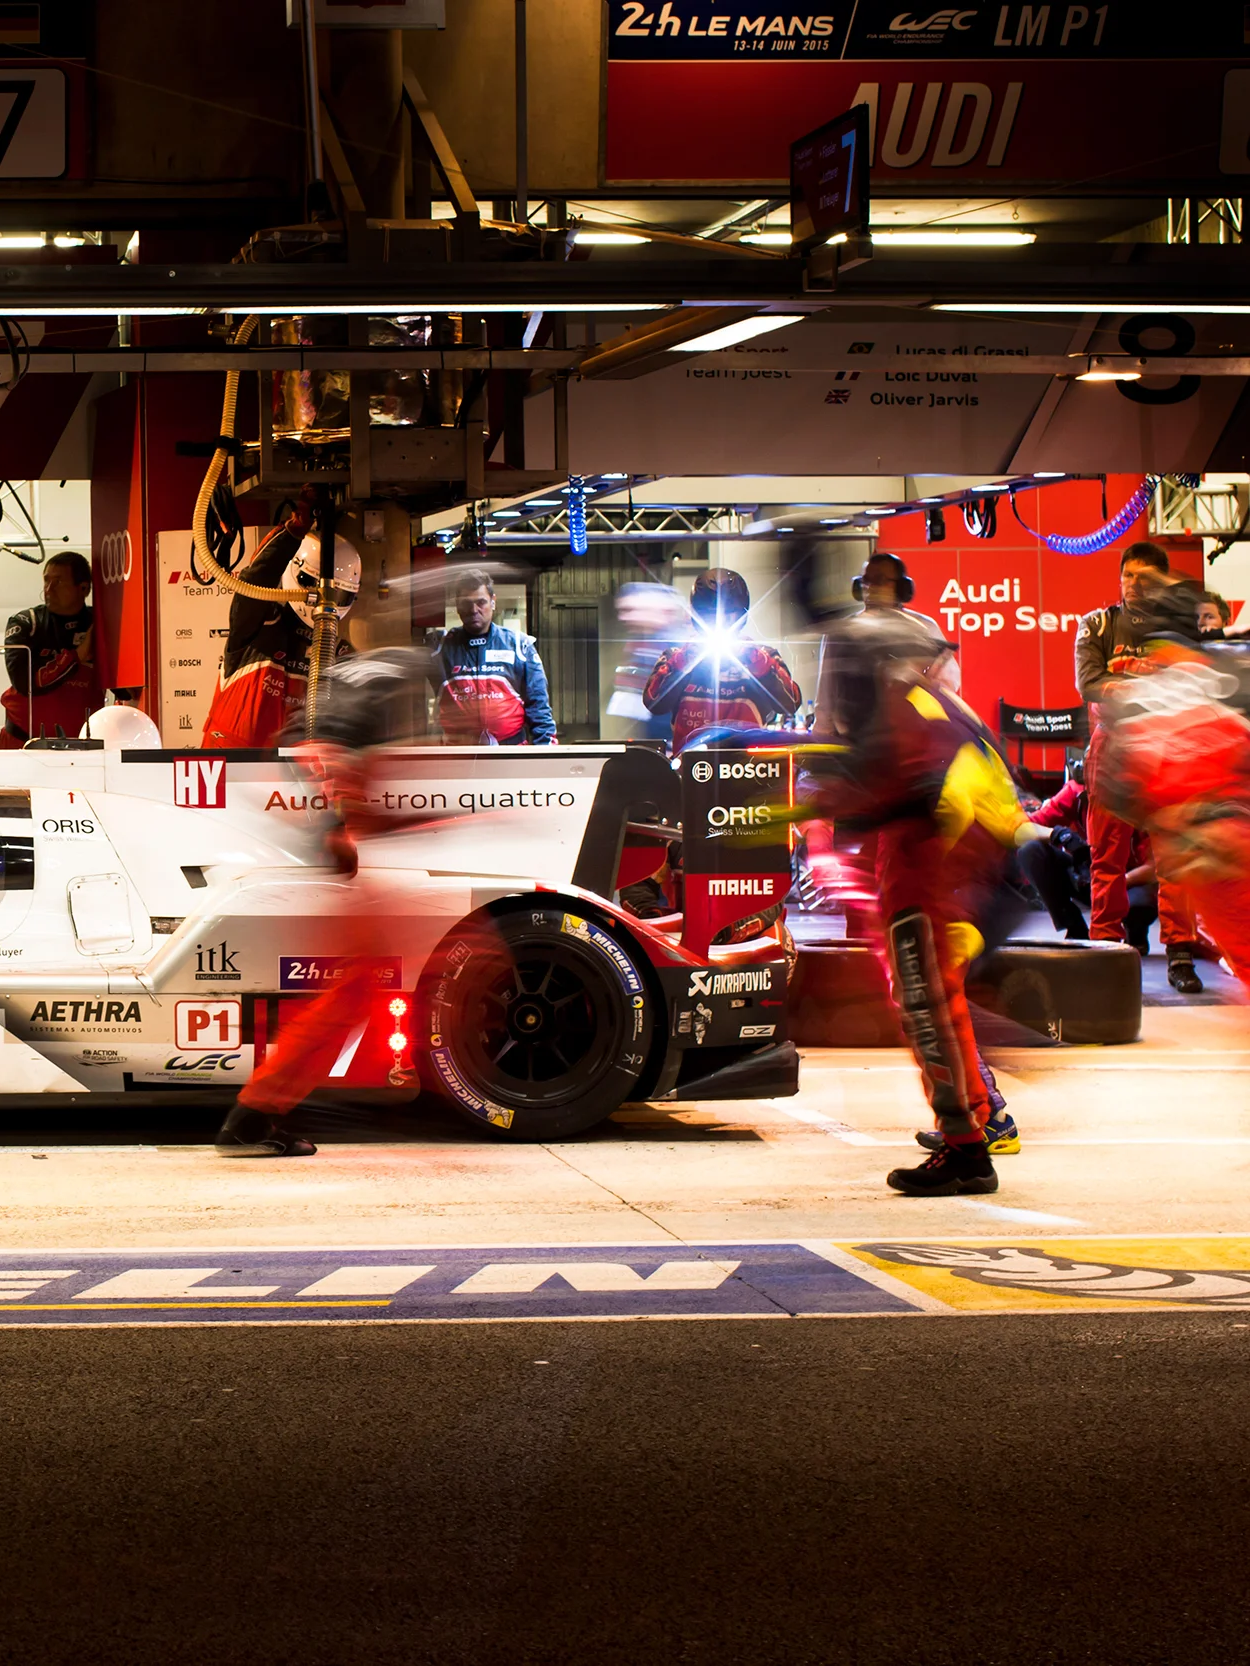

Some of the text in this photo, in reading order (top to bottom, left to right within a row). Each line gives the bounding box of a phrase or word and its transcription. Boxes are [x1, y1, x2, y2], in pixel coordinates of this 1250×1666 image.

[615, 1, 834, 36] 24h LE MANS
[888, 9, 979, 31] WEC
[994, 4, 1109, 46] LM P1
[734, 40, 830, 51] 13-14 JUIN 2015
[841, 128, 857, 214] 7
[870, 393, 979, 407] Oliver Jarvis
[183, 585, 213, 596] Team
[939, 578, 1021, 603] Audi
[940, 606, 1084, 637] Top Serv
[176, 629, 193, 637] ORIS
[178, 659, 202, 667] BOSCH
[481, 664, 505, 673] Sport
[174, 689, 197, 697] MAHLE
[179, 714, 193, 727] itk
[719, 763, 780, 779] BOSCH
[175, 760, 224, 805] HY
[458, 788, 575, 813] quattro
[707, 806, 771, 826] ORIS
[42, 819, 95, 834] ORIS
[708, 879, 774, 896] MAHLE
[195, 940, 241, 972] itk
[591, 931, 640, 990] MICHELIN
[288, 962, 321, 980] 24h
[713, 968, 772, 995] AKRAPOVIČ
[30, 1001, 142, 1022] AETHRA
[188, 1010, 229, 1041] P1
[165, 1054, 241, 1070] WEC
[434, 1052, 483, 1111] MICHELIN
